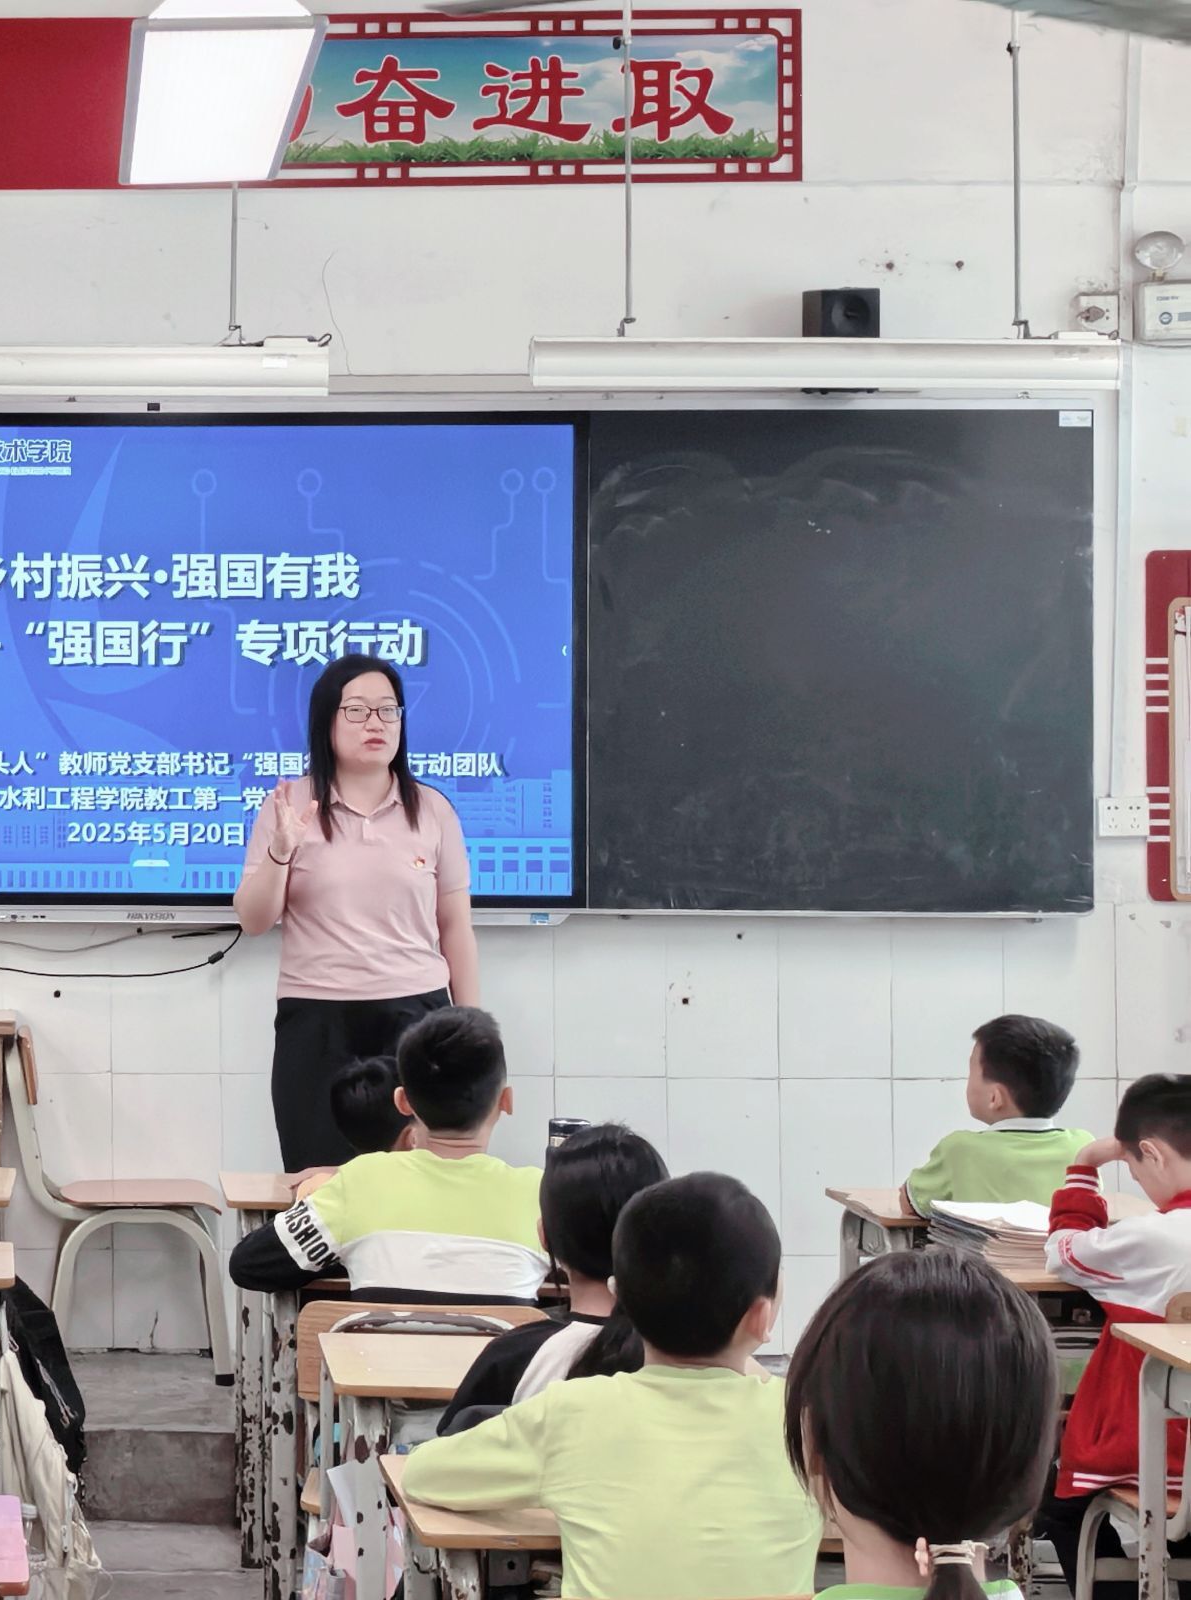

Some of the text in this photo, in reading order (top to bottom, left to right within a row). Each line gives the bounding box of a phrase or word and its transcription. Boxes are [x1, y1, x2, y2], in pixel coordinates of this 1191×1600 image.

[289, 55, 734, 144] 奋进取
[67, 821, 245, 846] 2025年5月20日
[126, 911, 177, 921] HIKVISION
[285, 1200, 341, 1269] FASHION
